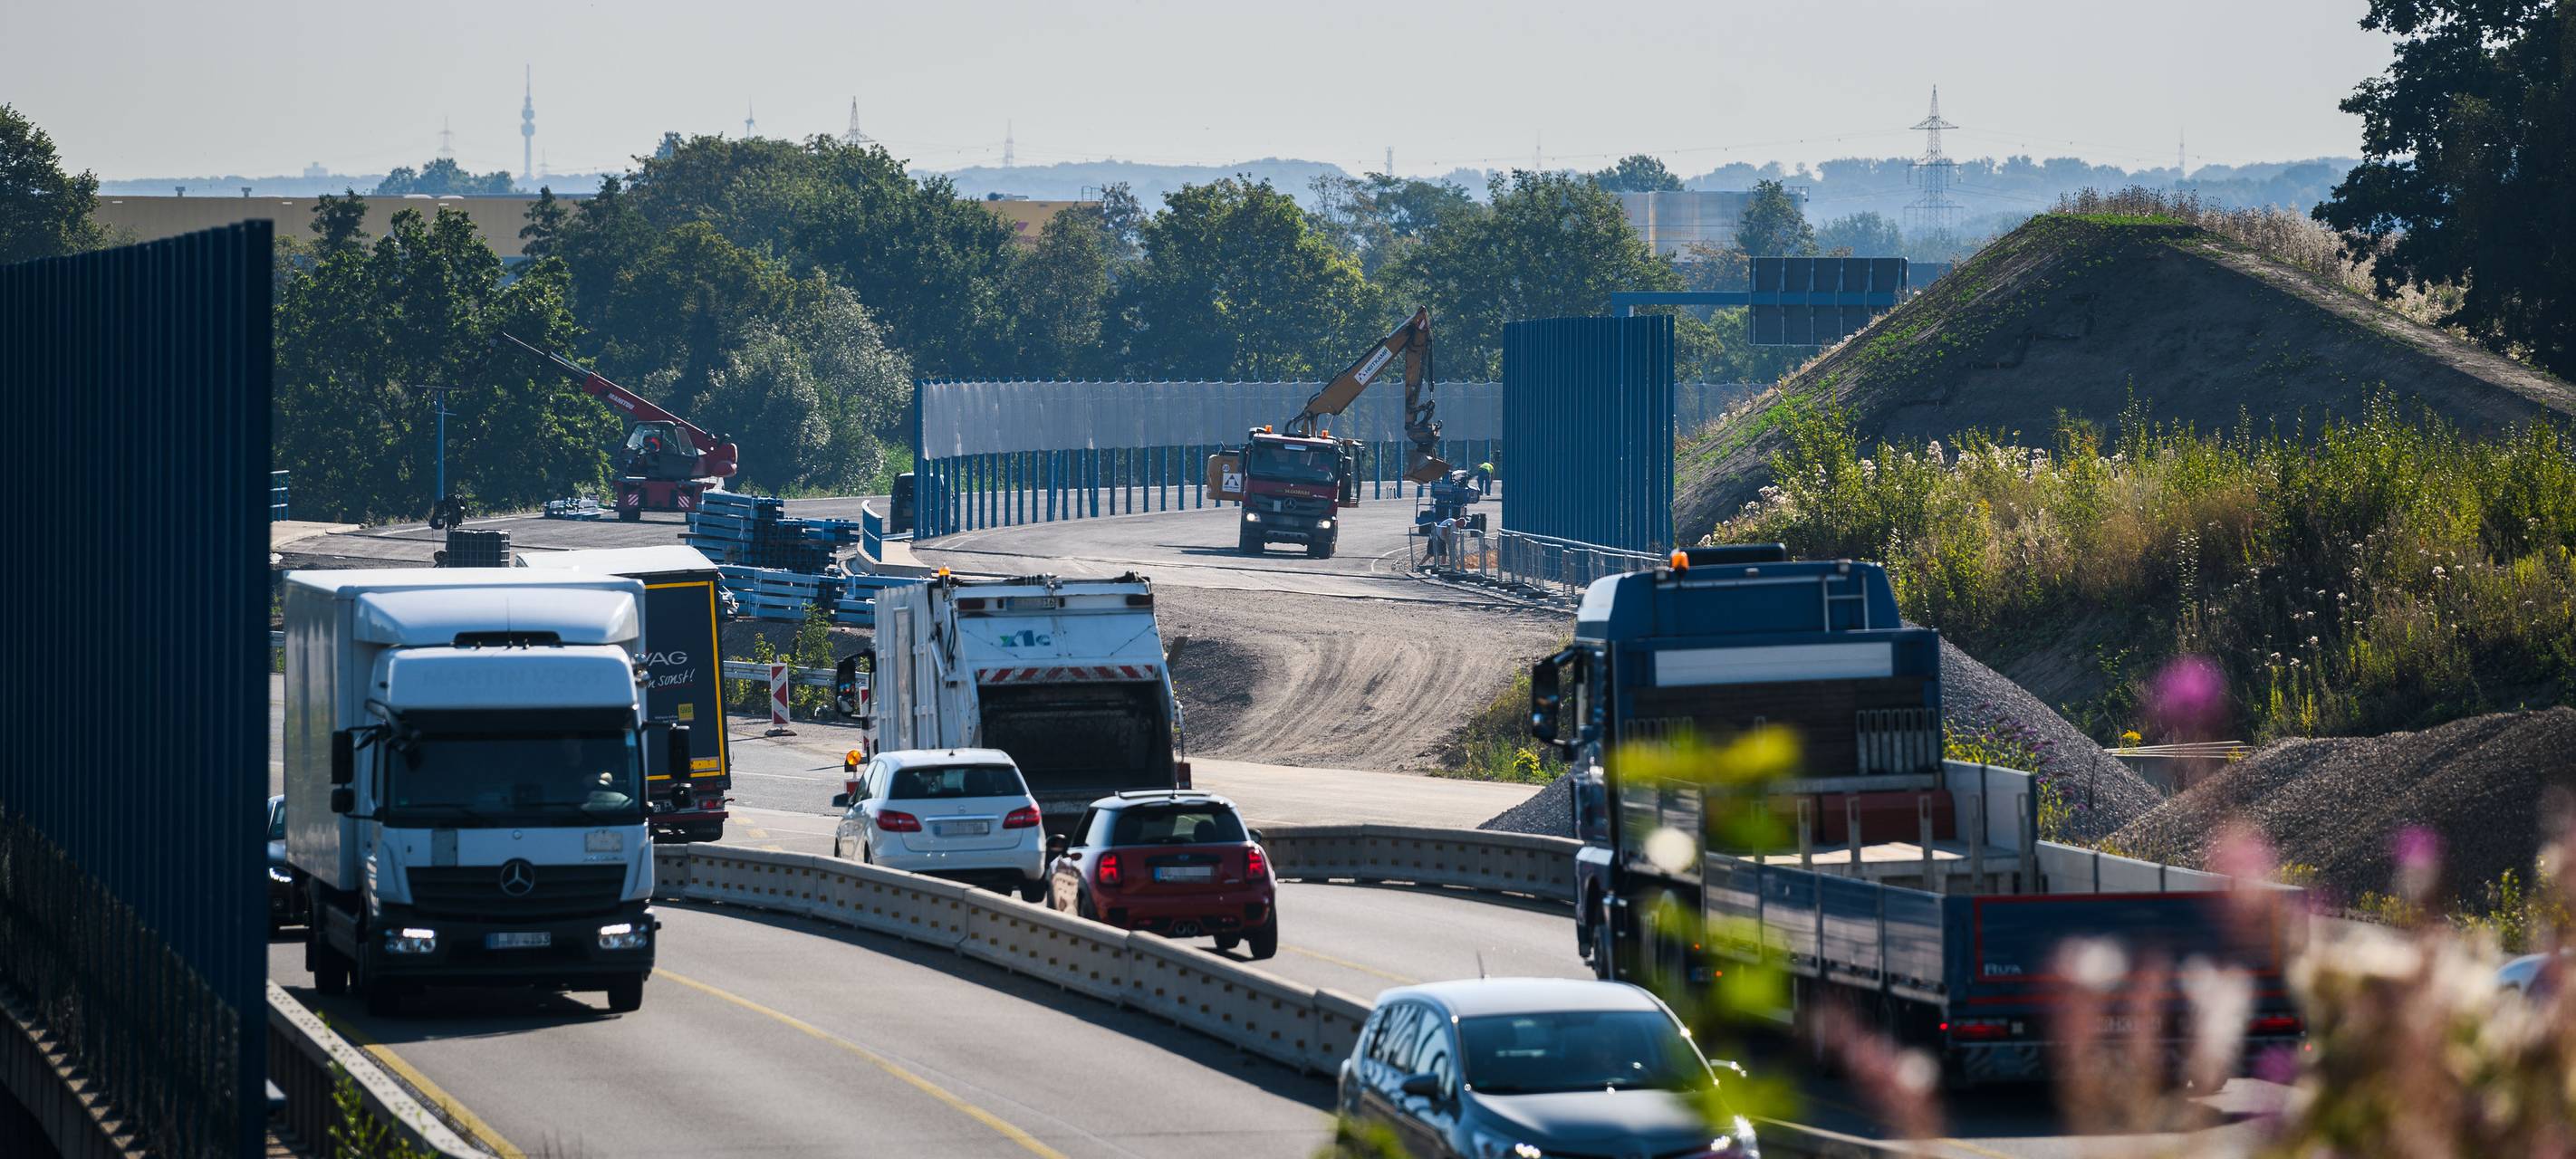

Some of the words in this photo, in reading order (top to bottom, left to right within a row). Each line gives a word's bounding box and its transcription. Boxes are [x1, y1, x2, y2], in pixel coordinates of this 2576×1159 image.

[1364, 350, 1388, 373] HEITKAMP
[608, 393, 634, 409] MANITOU
[658, 667, 696, 686] sonst!
